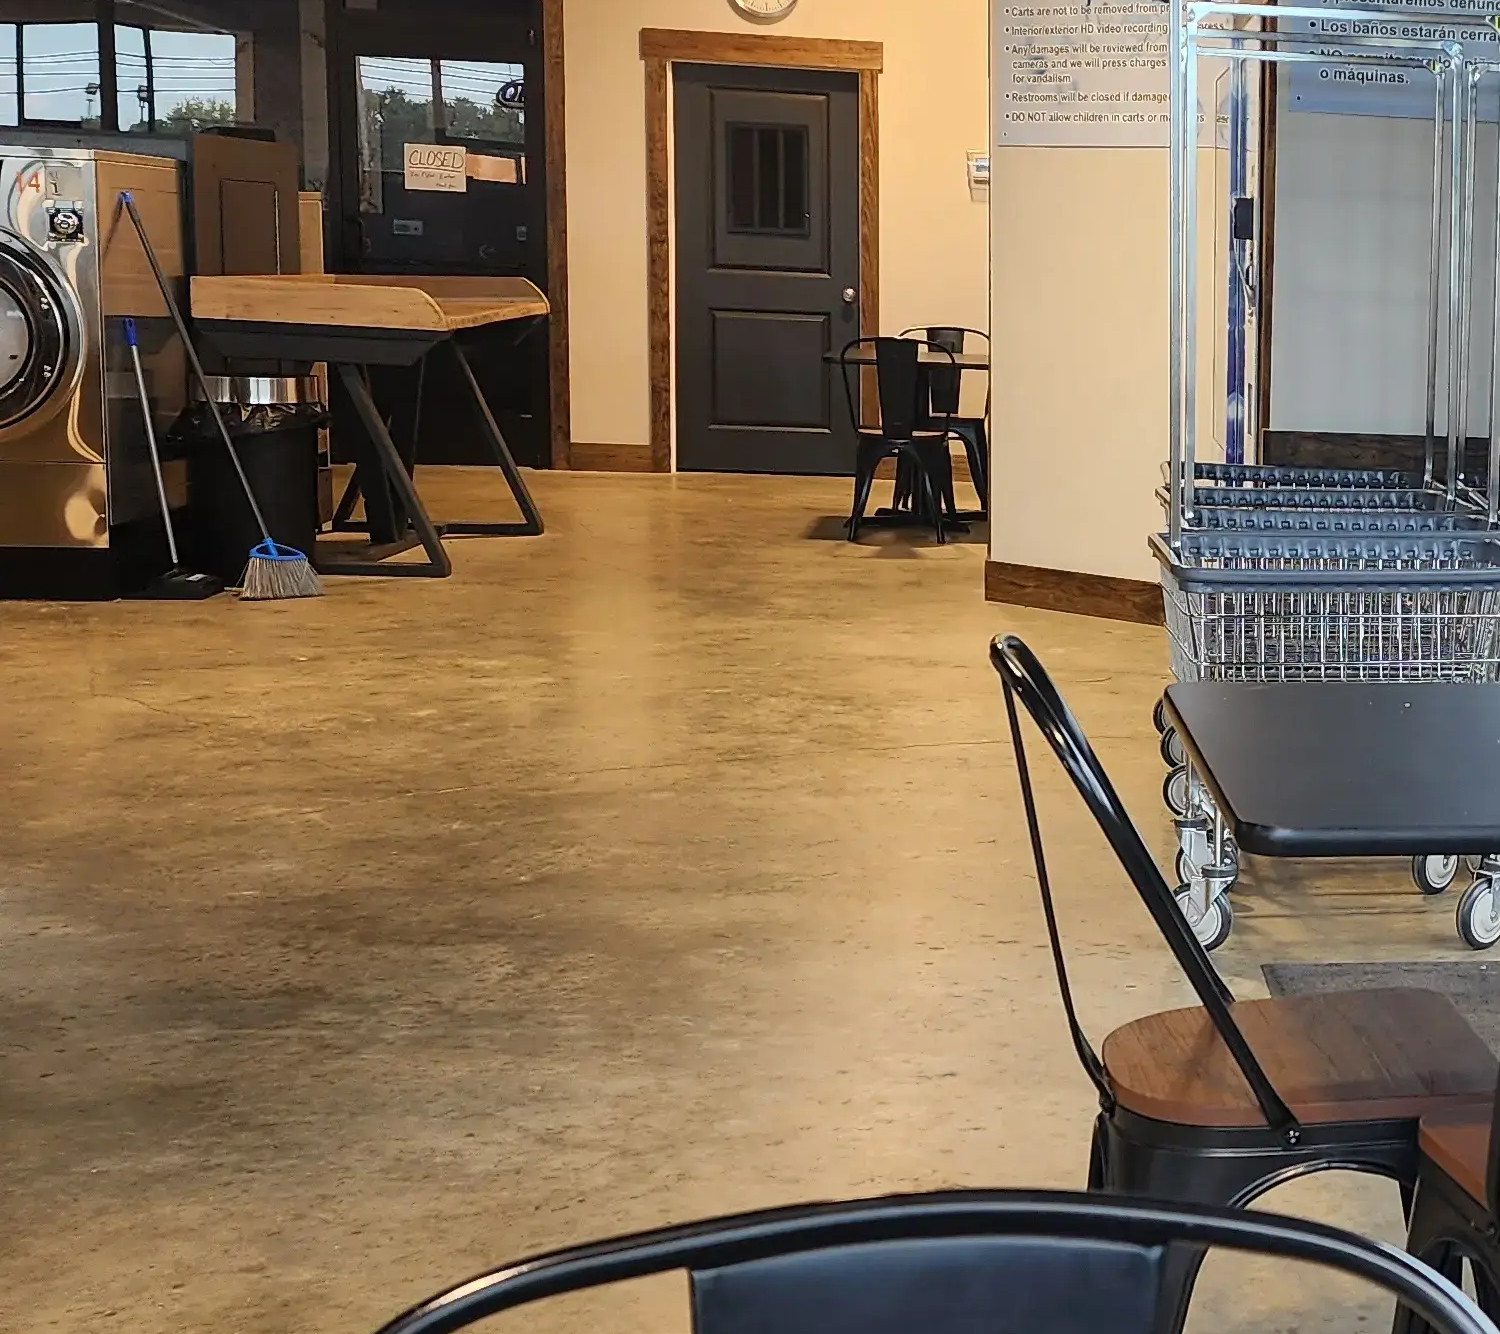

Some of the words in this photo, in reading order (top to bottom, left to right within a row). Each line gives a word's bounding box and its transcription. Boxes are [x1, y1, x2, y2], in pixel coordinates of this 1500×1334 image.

[1321, 19, 1348, 33] Los
[1352, 21, 1397, 36] baños
[1402, 25, 1456, 40] estarán
[1320, 69, 1329, 79] o
[1333, 68, 1409, 85] máquinas.
[1011, 112, 1025, 121] DO
[1028, 112, 1045, 121] NOT
[1048, 112, 1072, 121] allow
[1072, 112, 1109, 122] children
[1111, 112, 1120, 122] in
[1121, 113, 1145, 122] carts
[1147, 114, 1157, 122] or
[408, 149, 464, 169] CLOSED
